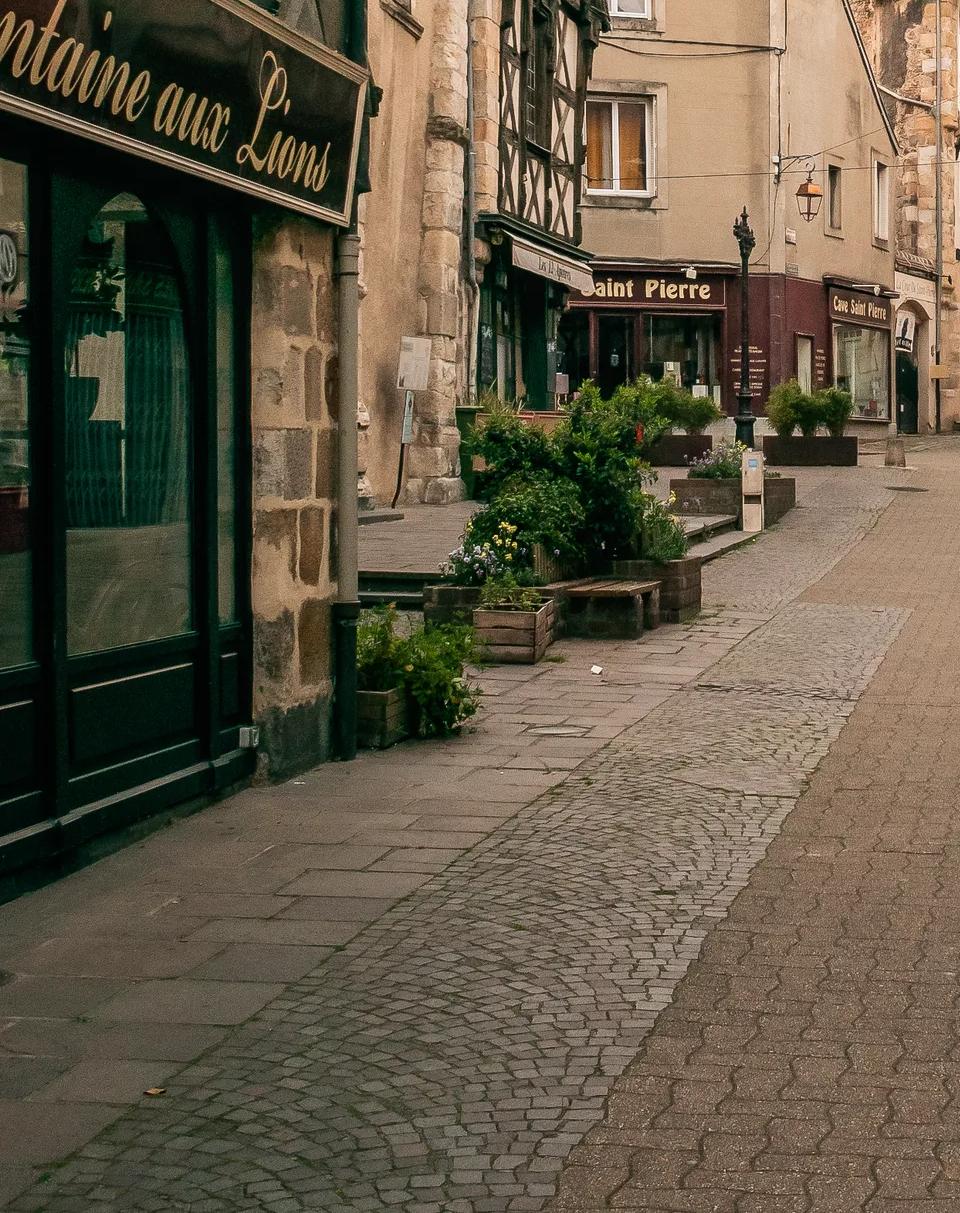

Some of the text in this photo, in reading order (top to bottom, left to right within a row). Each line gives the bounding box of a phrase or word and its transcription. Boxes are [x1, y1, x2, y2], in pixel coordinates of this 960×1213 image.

[153, 82, 231, 153] aux
[236, 50, 331, 193] Lions
[645, 278, 711, 299] Pierre
[833, 295, 887, 320] Cave Saint Pierre
